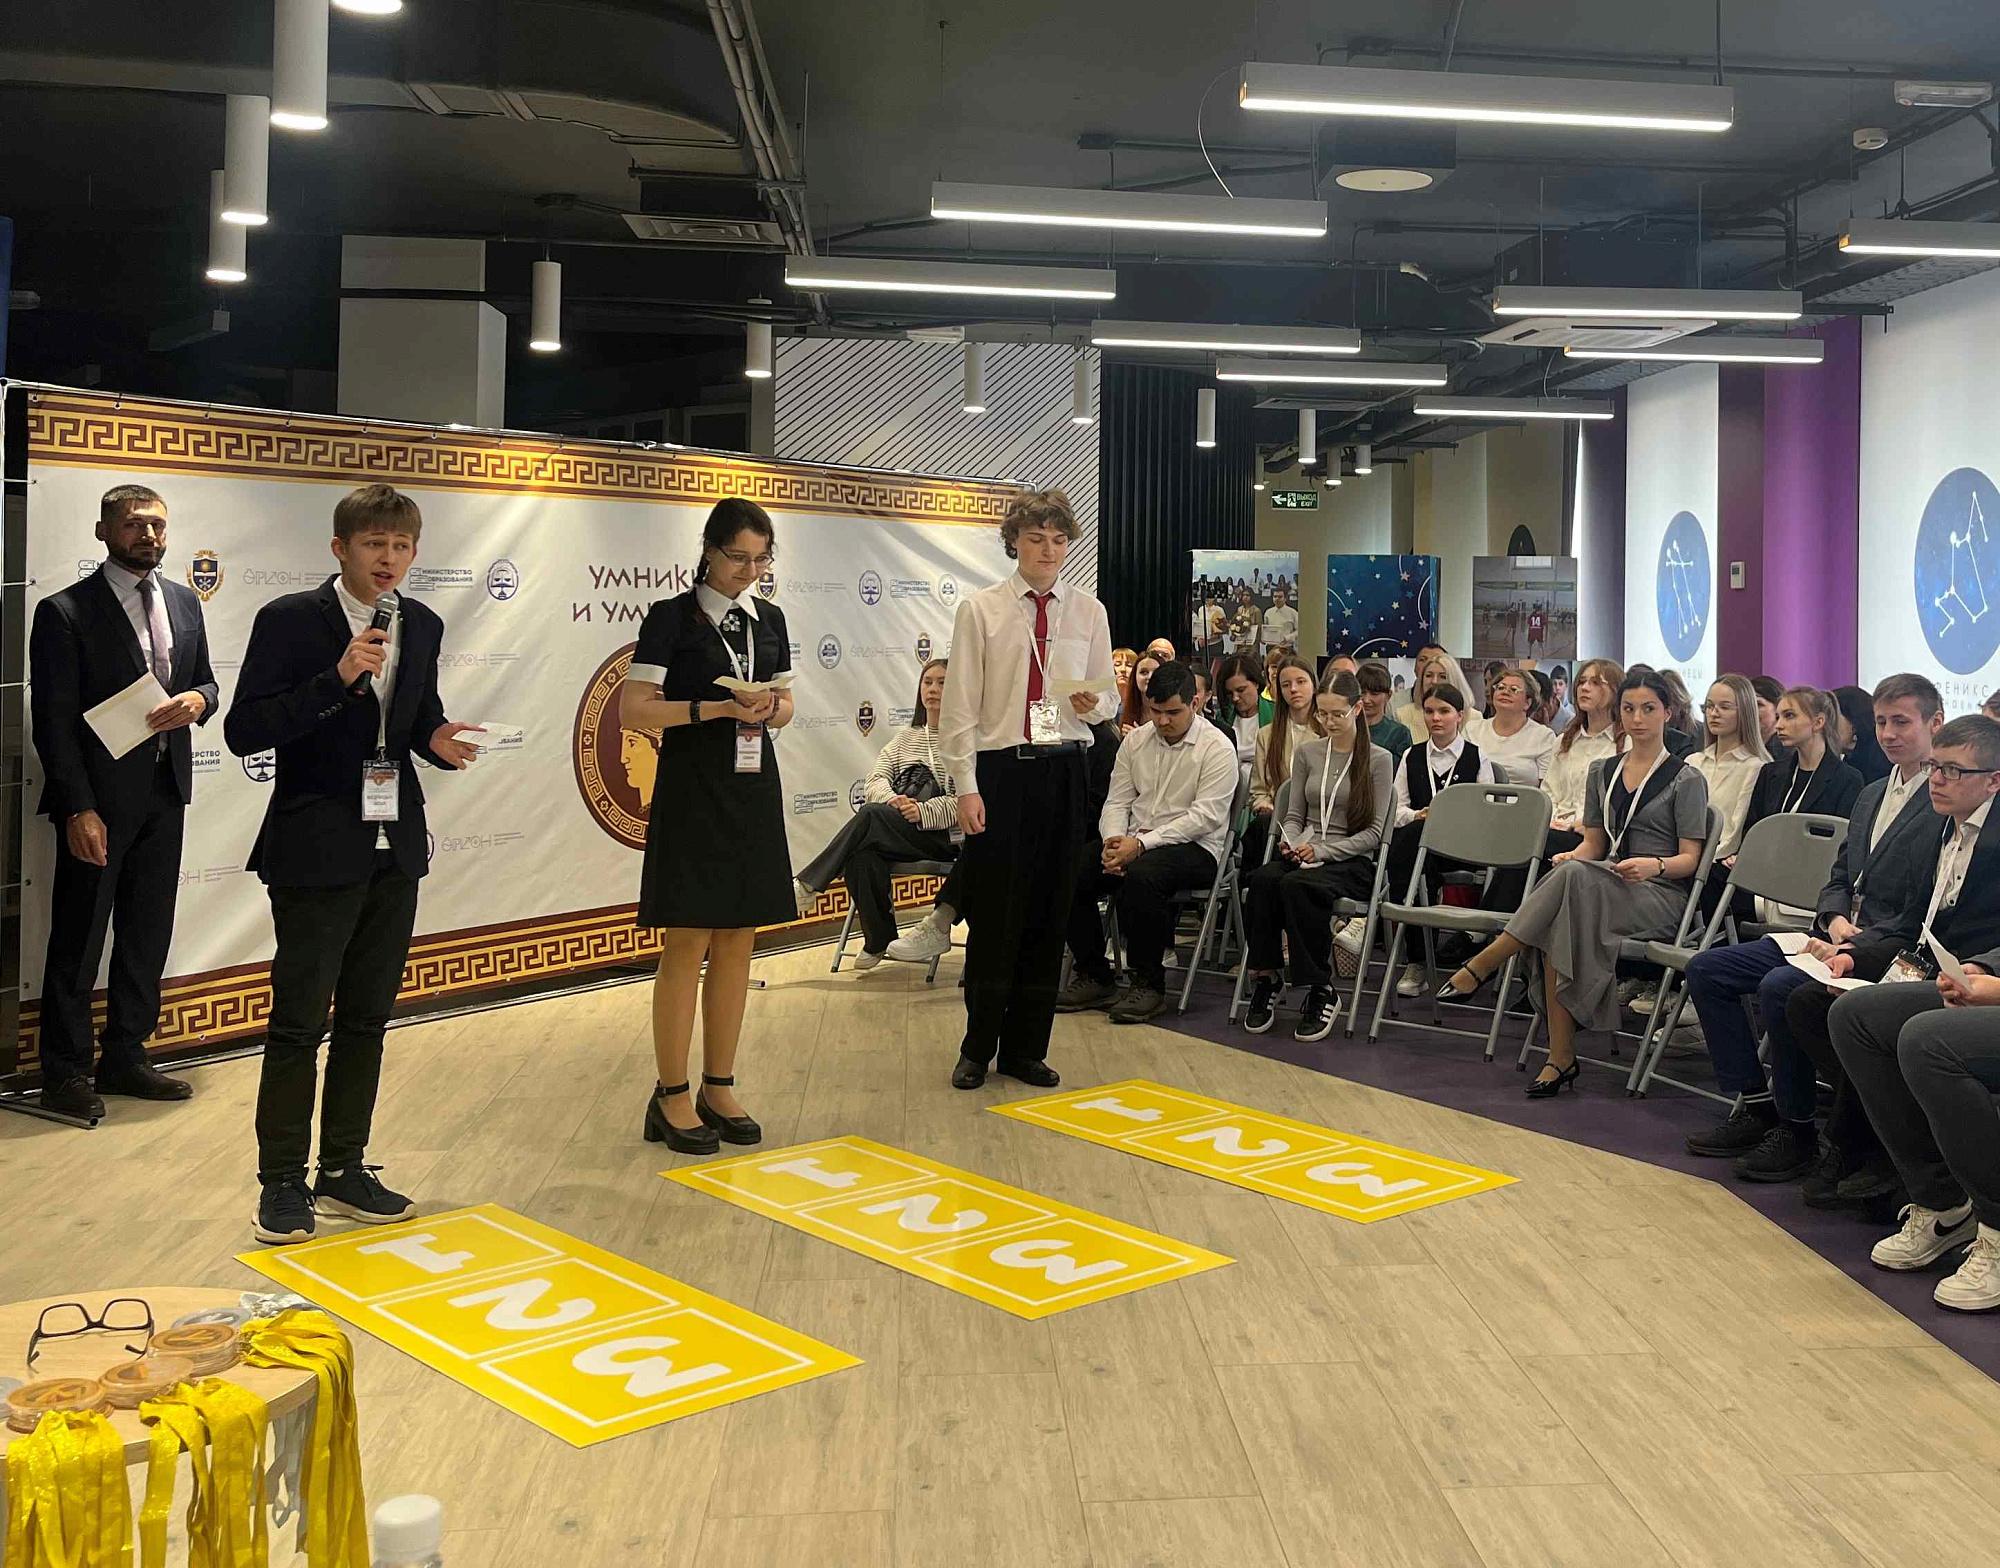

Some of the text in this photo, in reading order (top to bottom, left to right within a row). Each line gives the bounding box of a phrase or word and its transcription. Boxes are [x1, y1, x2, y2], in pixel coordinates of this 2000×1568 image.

[422, 568, 473, 576] МИНИСТЕРСТВО
[572, 602, 591, 622] И
[1075, 1097, 1428, 1198] 1 2 3
[759, 1157, 1128, 1285] 1 2 3
[357, 1232, 731, 1398] 1 2 3
